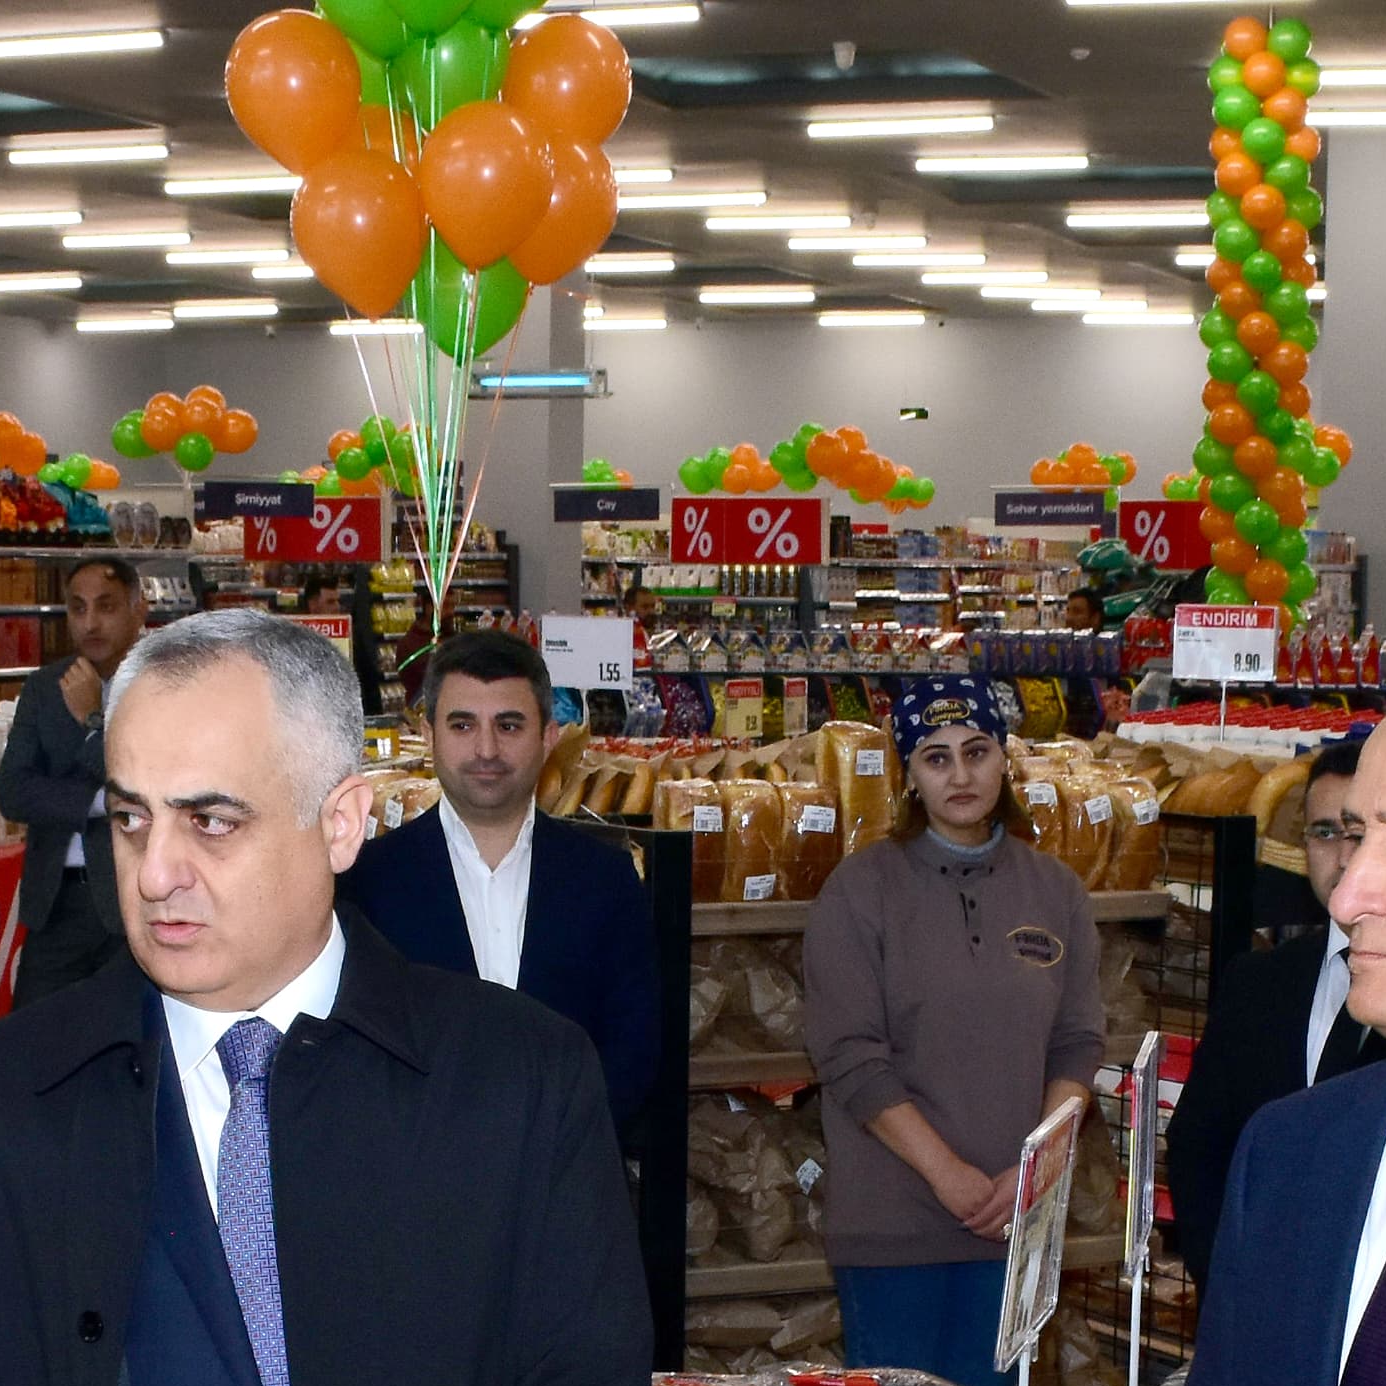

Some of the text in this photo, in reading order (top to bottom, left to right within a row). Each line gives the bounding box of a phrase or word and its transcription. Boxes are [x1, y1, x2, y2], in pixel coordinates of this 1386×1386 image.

[1192, 609, 1258, 627] ENDİRİM
[599, 662, 621, 682] 1.55
[1234, 652, 1261, 673] 8.90
